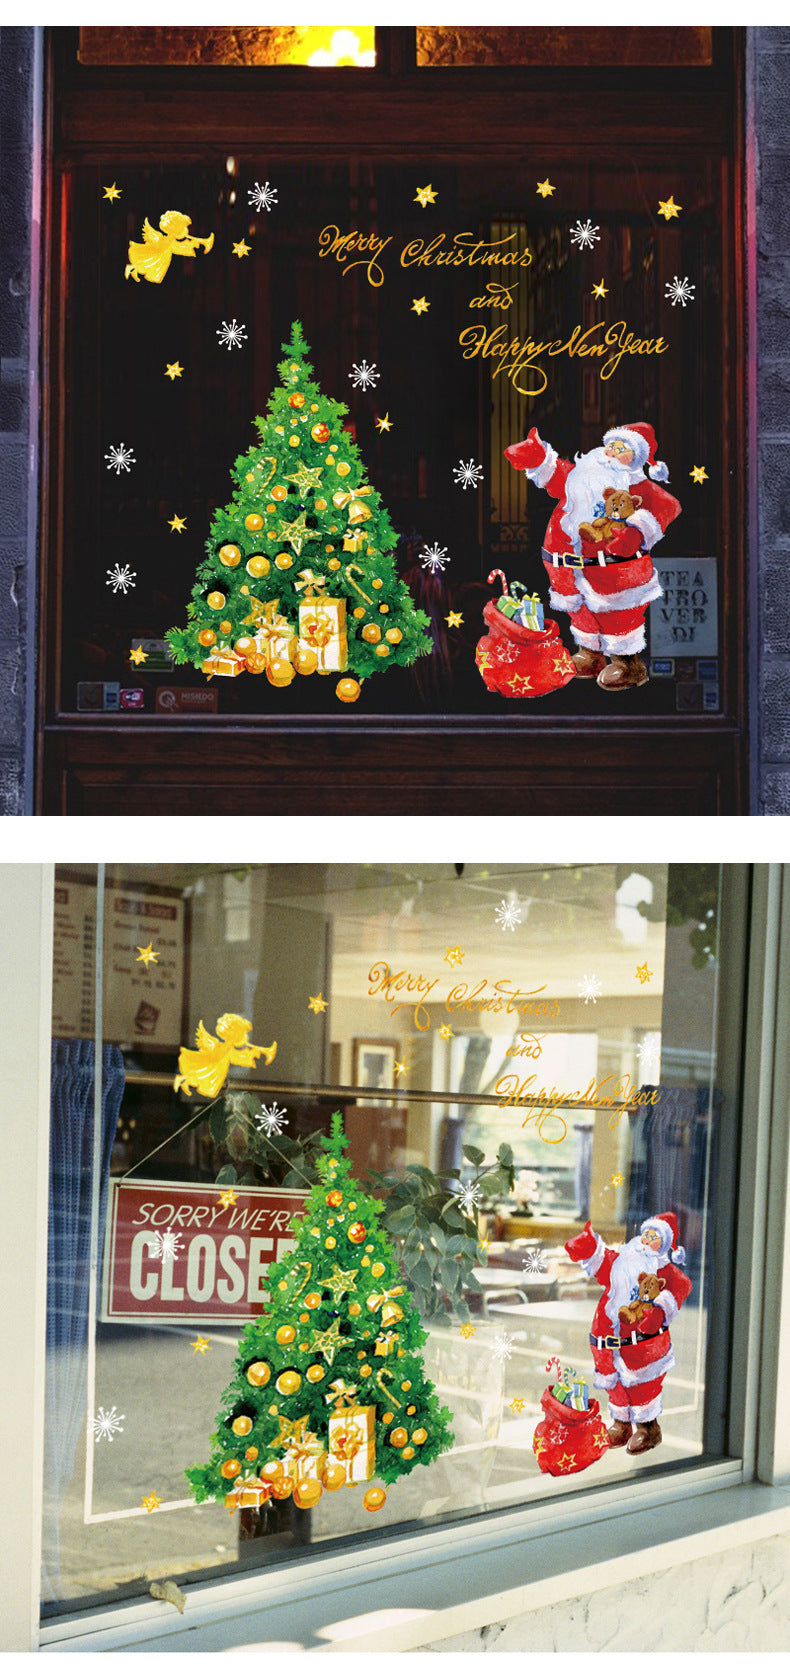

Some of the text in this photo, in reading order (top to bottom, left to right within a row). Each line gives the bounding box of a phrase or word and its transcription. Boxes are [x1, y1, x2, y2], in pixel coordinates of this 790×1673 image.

[319, 224, 534, 287] Merry Christmas
[469, 282, 520, 310] and
[458, 324, 552, 396] Happy
[600, 320, 669, 380] Year
[660, 571, 705, 587] TEA
[662, 589, 709, 606] TRO
[660, 608, 707, 624] VER
[672, 626, 696, 643] DI
[368, 961, 562, 1031] Merry Christmas
[506, 1032, 549, 1060] and
[495, 1073, 572, 1145] Happy
[608, 1073, 662, 1130] Year
[132, 1203, 305, 1232] SORRY WE'RE
[129, 1230, 300, 1304] CLOSE
